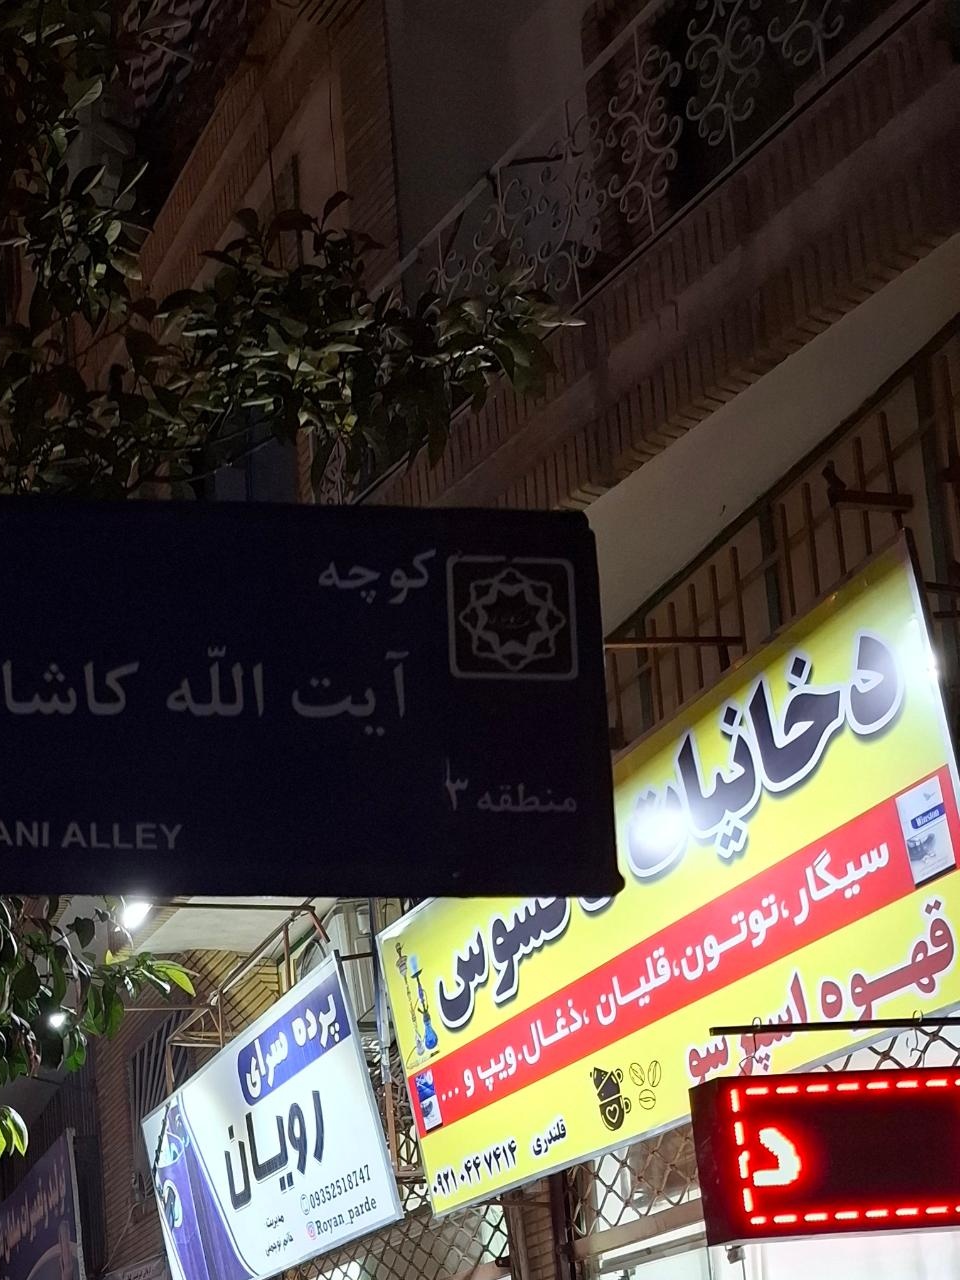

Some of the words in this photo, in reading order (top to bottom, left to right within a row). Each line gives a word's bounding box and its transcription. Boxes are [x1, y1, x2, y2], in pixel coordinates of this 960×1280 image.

[318, 549, 437, 604] کوچه
[291, 651, 410, 737] آیت
[627, 634, 902, 873] دخانیات
[444, 777, 469, 811] ۳
[477, 784, 577, 813] منطقه
[60, 821, 183, 851] ALLEY
[820, 899, 955, 1032] قهوه
[292, 994, 340, 1050] پرده
[246, 1031, 289, 1099] سرای
[463, 1068, 475, 1098] و
[224, 1089, 325, 1209] رویان
[532, 1118, 567, 1156] قلندری
[309, 1164, 371, 1209] 09352518747
[315, 1196, 377, 1236] Royan_parde
